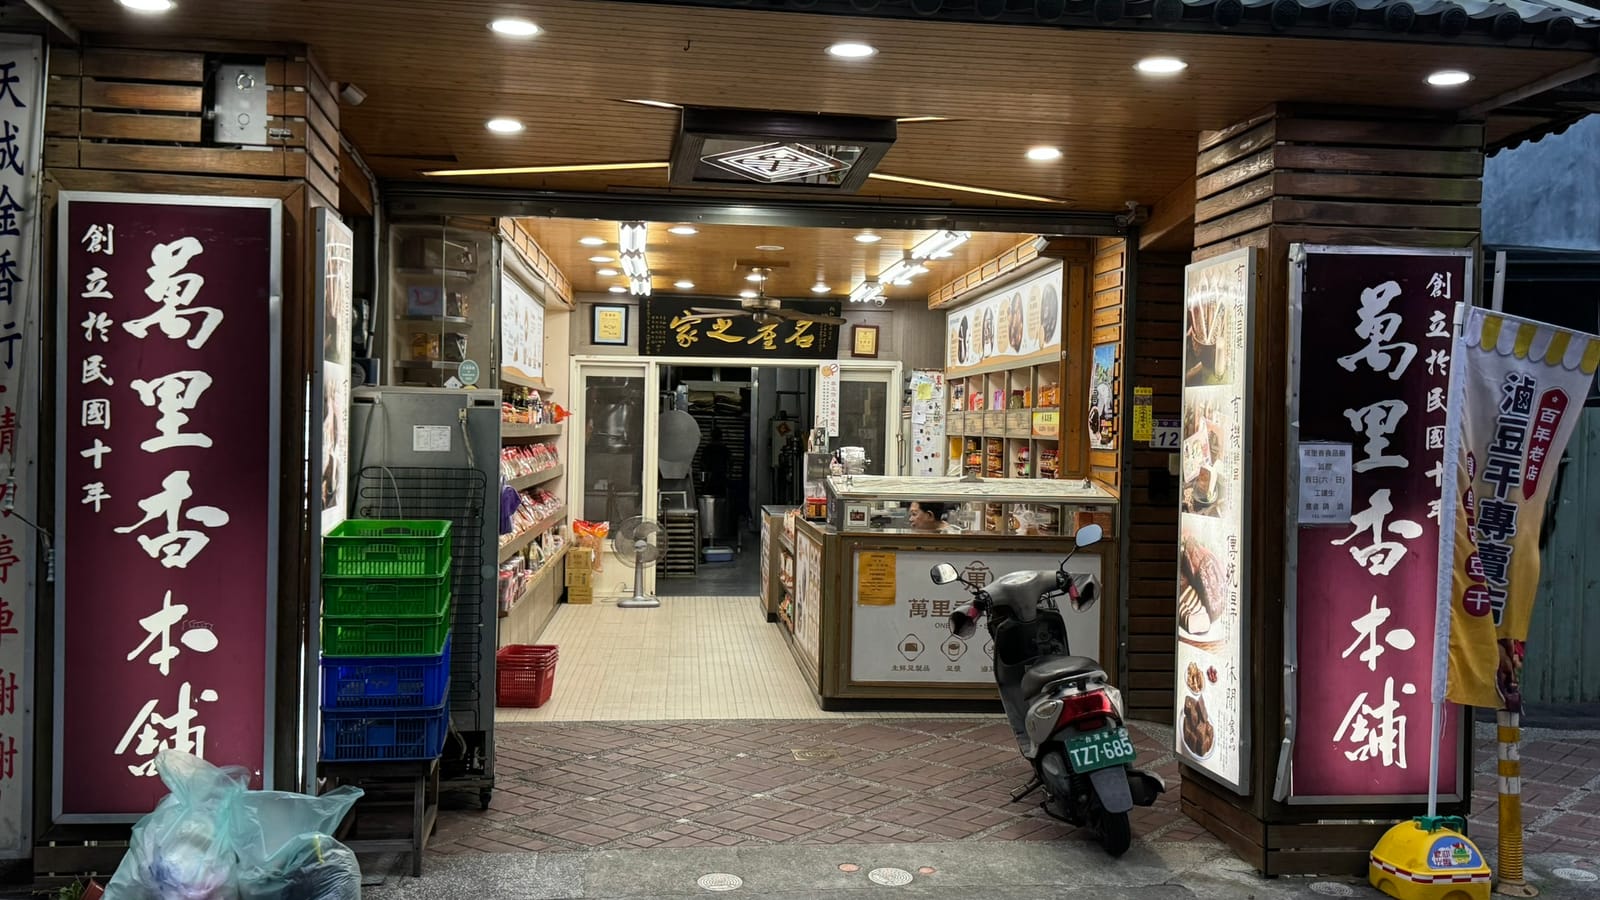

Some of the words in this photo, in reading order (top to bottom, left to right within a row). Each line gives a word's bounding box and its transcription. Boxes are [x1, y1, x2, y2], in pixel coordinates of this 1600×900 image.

[81, 223, 114, 513] 創立於民國十年
[1526, 406, 1560, 482] 百年老店
[908, 598, 966, 618] 萬里
